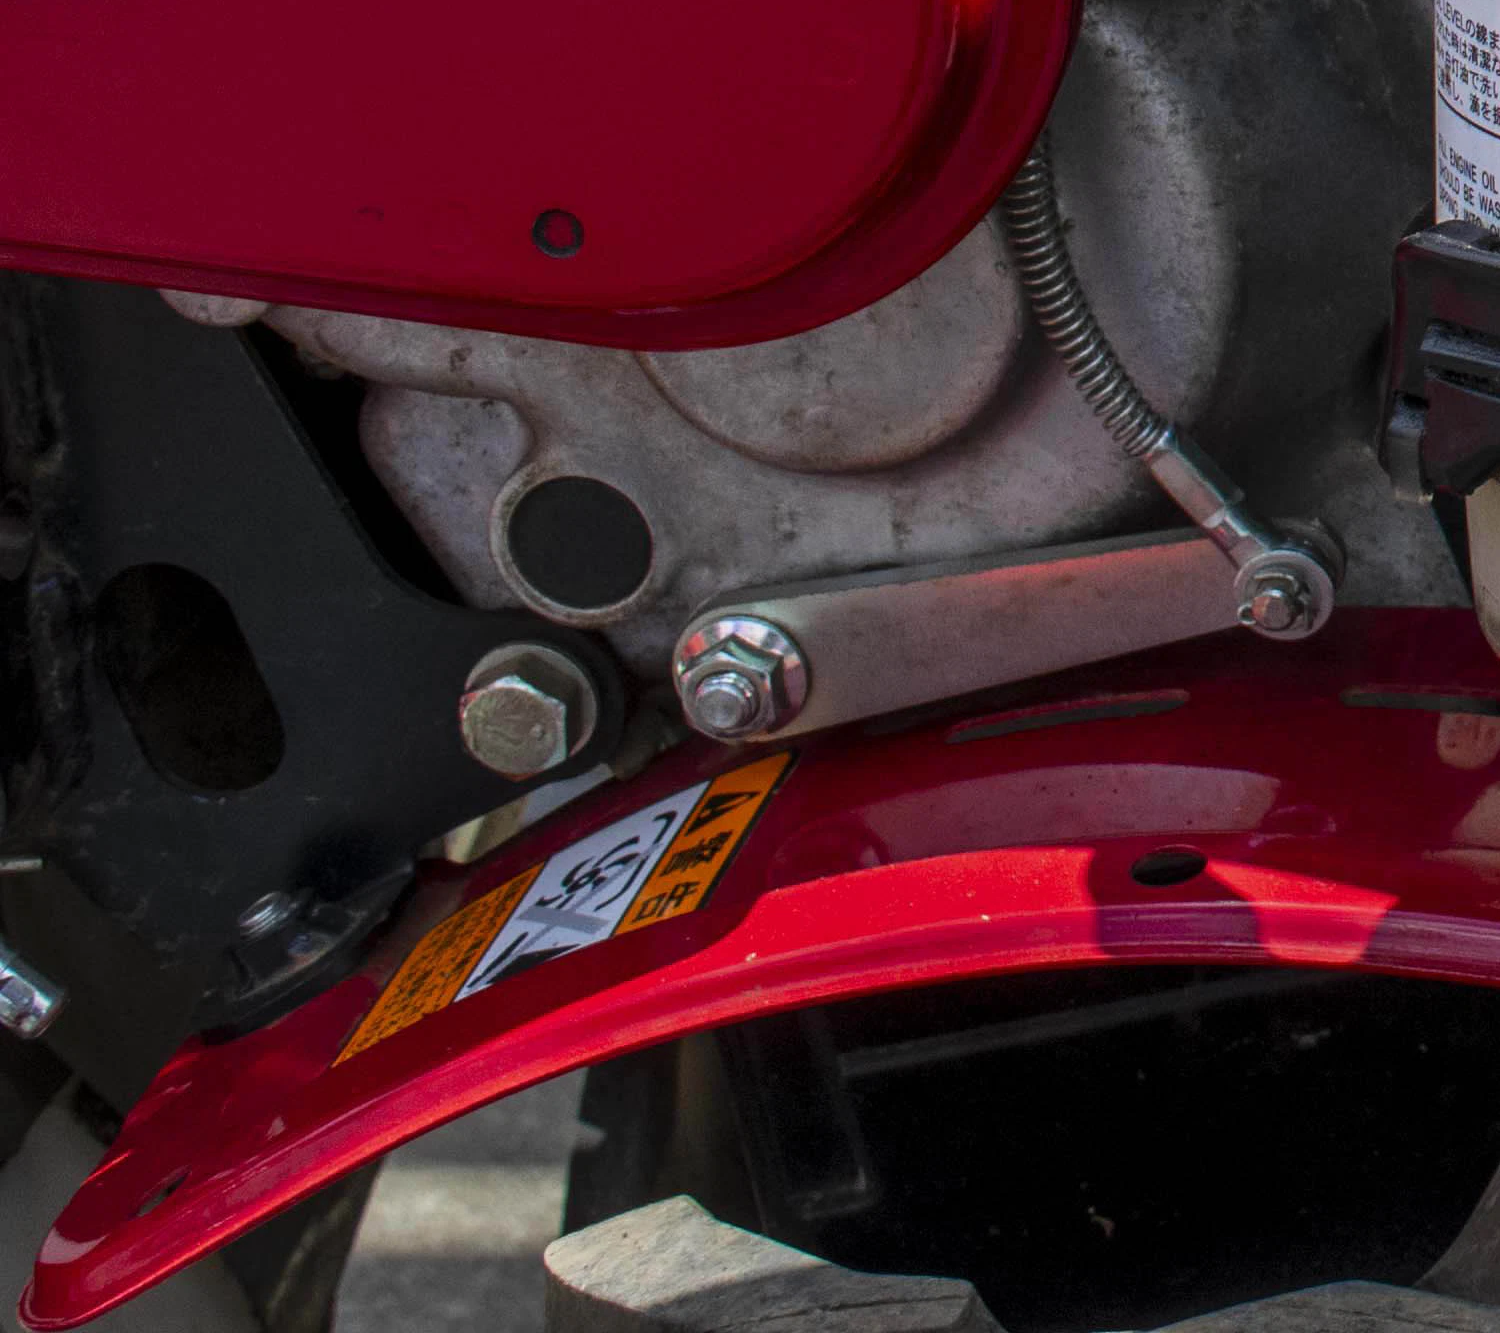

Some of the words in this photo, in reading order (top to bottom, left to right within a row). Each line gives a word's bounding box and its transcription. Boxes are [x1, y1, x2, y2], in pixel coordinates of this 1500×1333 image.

[1449, 146, 1478, 183] ENGINE
[1481, 169, 1499, 195] OIL
[1463, 184, 1475, 206] BE
